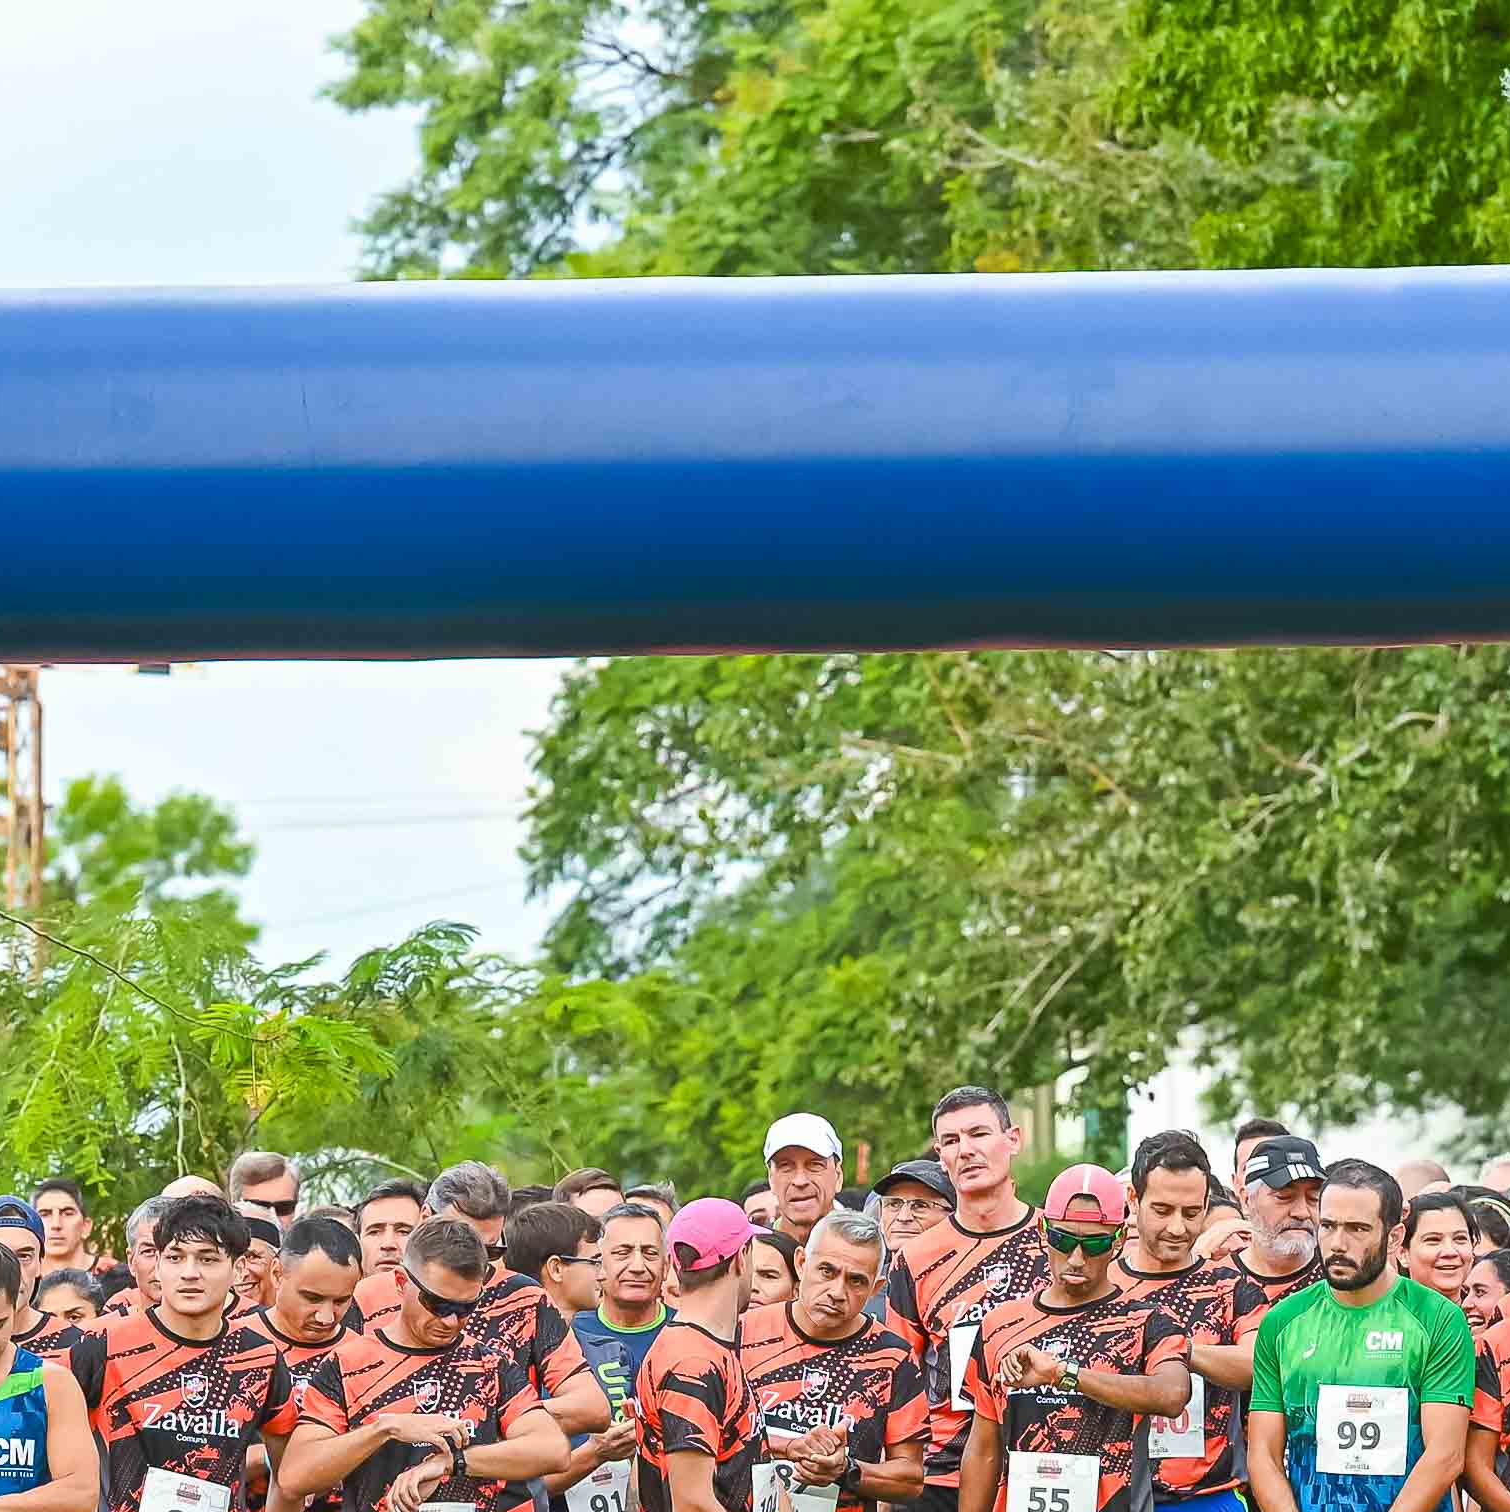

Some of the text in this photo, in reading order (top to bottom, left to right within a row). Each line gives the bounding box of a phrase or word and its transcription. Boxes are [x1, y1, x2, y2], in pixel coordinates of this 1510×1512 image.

[1366, 1331, 1404, 1351] CM
[1036, 1395, 1068, 1405] Comuna
[142, 1403, 240, 1439] Zavalla
[175, 1434, 208, 1445] Comuna
[1337, 1421, 1381, 1450] 99
